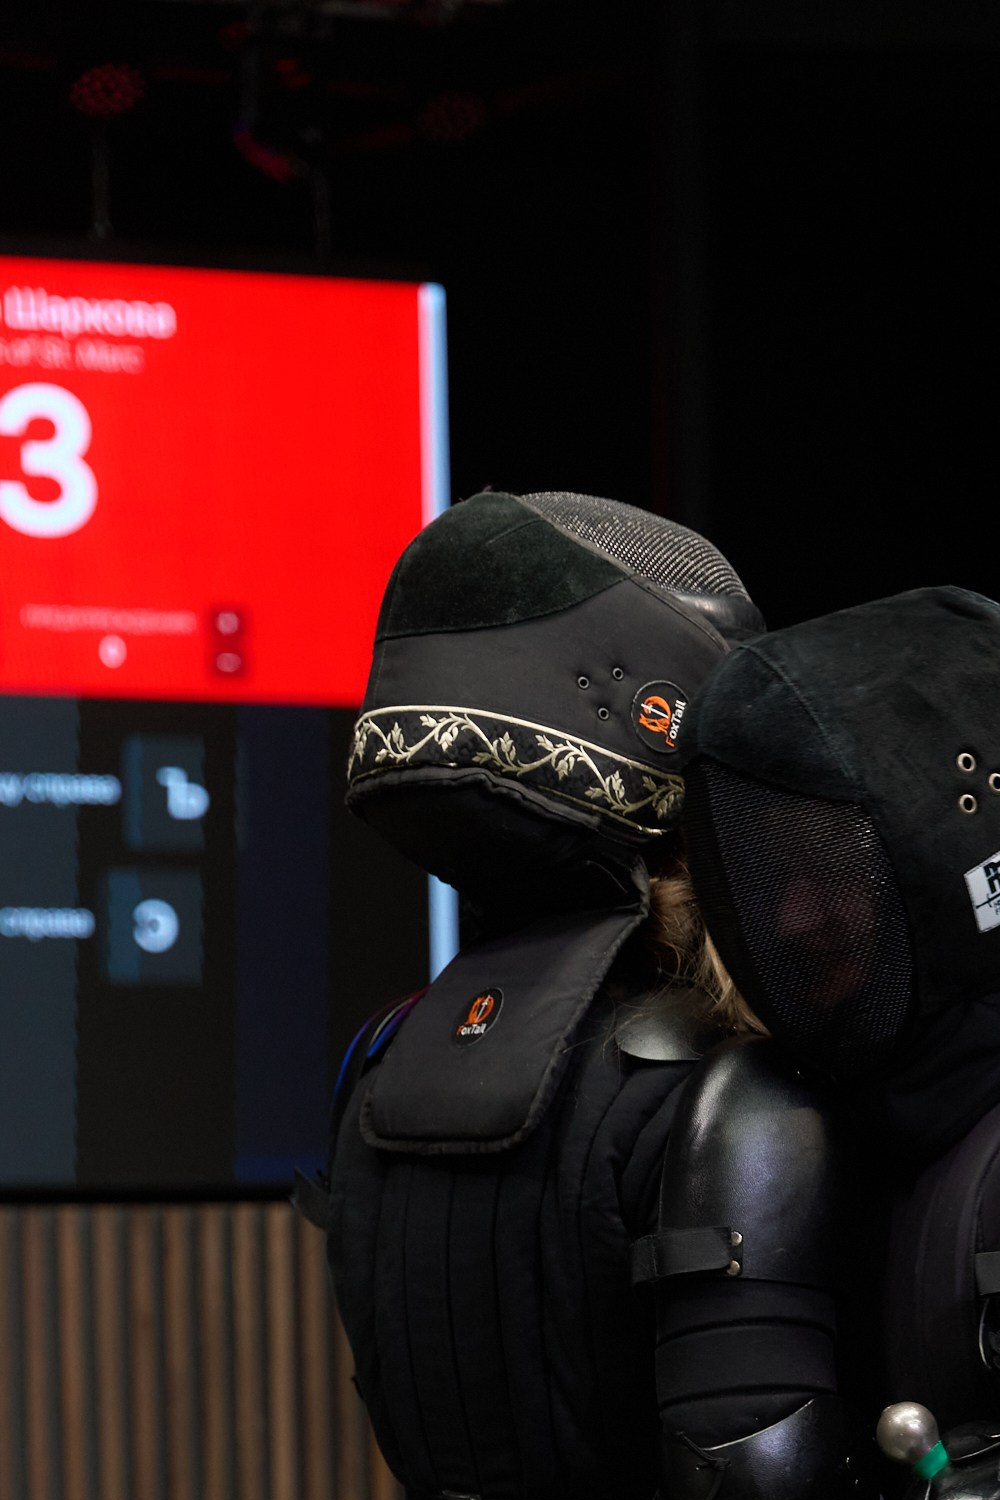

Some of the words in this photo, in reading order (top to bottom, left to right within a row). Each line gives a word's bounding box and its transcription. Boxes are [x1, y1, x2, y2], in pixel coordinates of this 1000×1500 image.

[0, 382, 98, 538] 3
[665, 699, 687, 749] FoxTail
[456, 1023, 488, 1036] FoxTail
